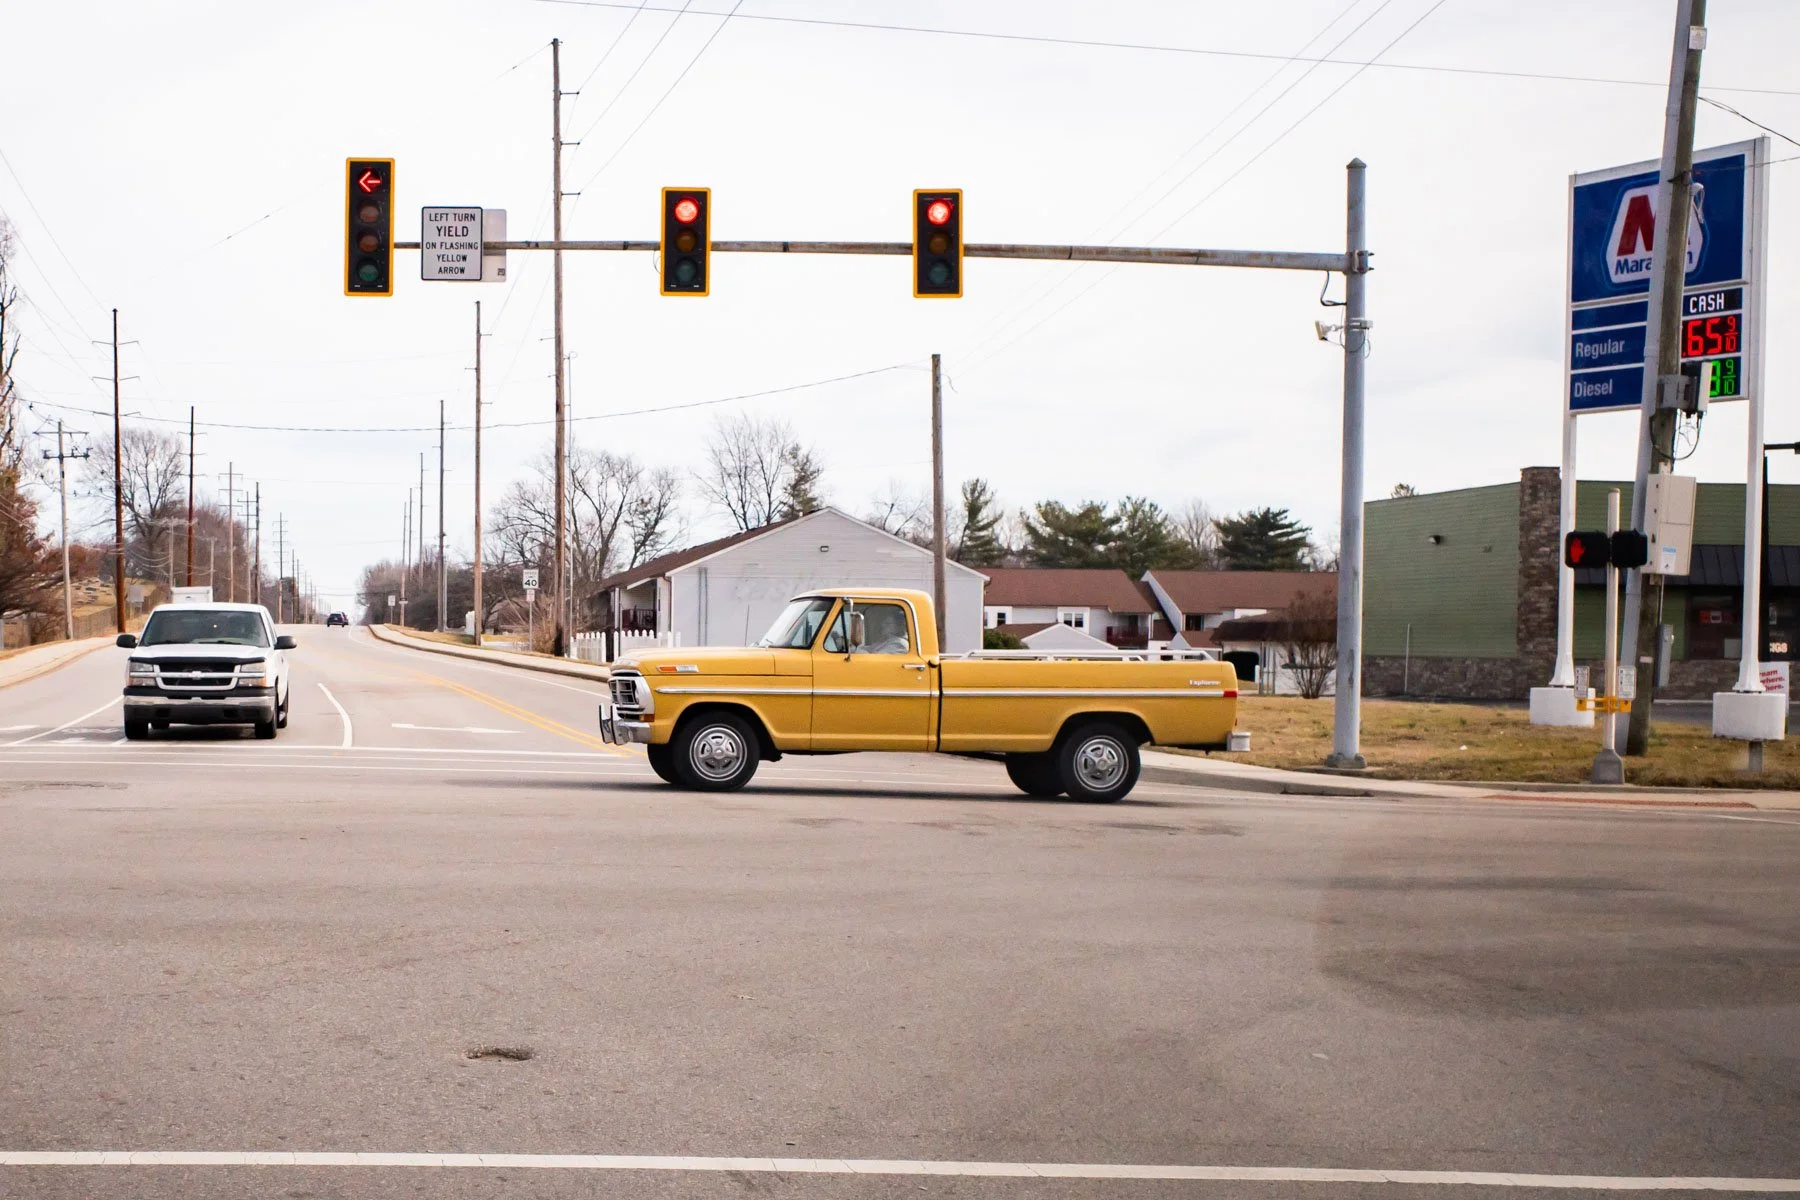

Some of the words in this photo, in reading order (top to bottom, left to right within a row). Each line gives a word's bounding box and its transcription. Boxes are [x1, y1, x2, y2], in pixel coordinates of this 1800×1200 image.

[429, 212, 449, 222] LEFT
[453, 212, 476, 222] TURN
[436, 225, 469, 237] YIELD
[425, 241, 437, 250] ON
[440, 241, 479, 250] FLASHING
[436, 253, 468, 263] YELLOW
[1615, 251, 1693, 275] Maran
[438, 266, 466, 275] ARROW
[1689, 292, 1725, 313] CASH
[1575, 338, 1625, 359] Regular
[1574, 378, 1613, 398] Diesel
[524, 579, 538, 587] 40
